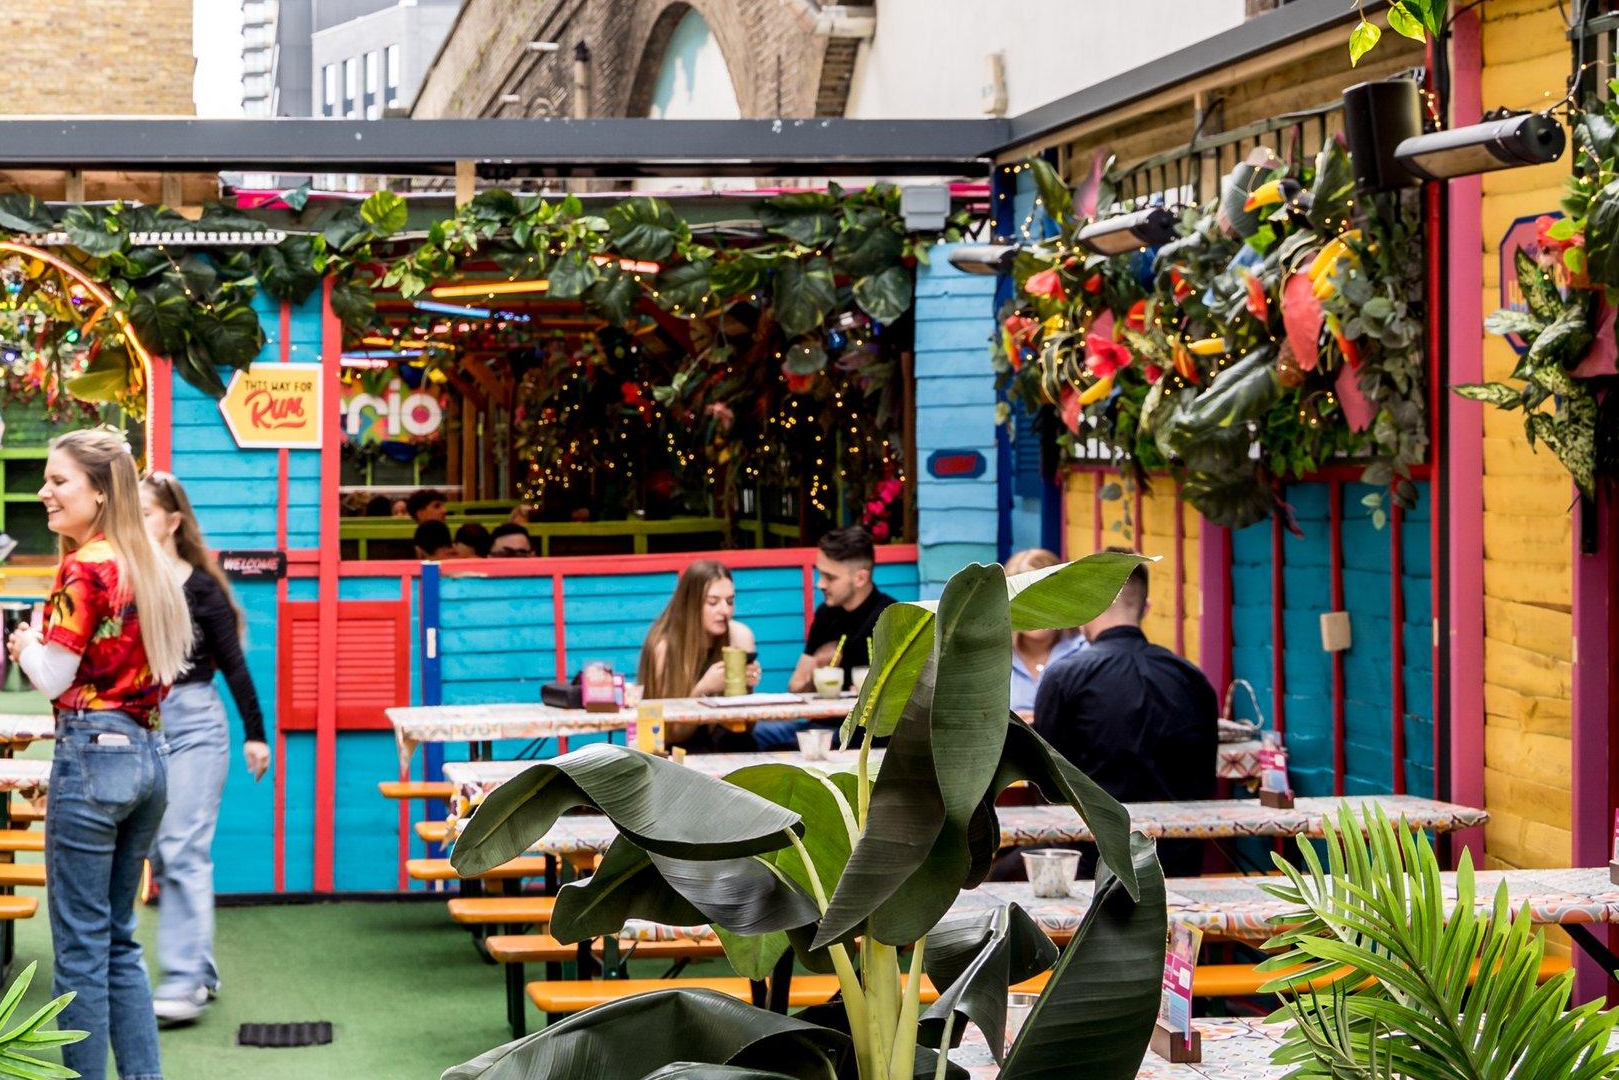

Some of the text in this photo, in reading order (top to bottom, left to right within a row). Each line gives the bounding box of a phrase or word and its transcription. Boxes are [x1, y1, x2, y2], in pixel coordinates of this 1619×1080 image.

[244, 380, 313, 392] THIS WAY FOR
[340, 379, 442, 436] rio
[223, 557, 280, 571] WELCOME
